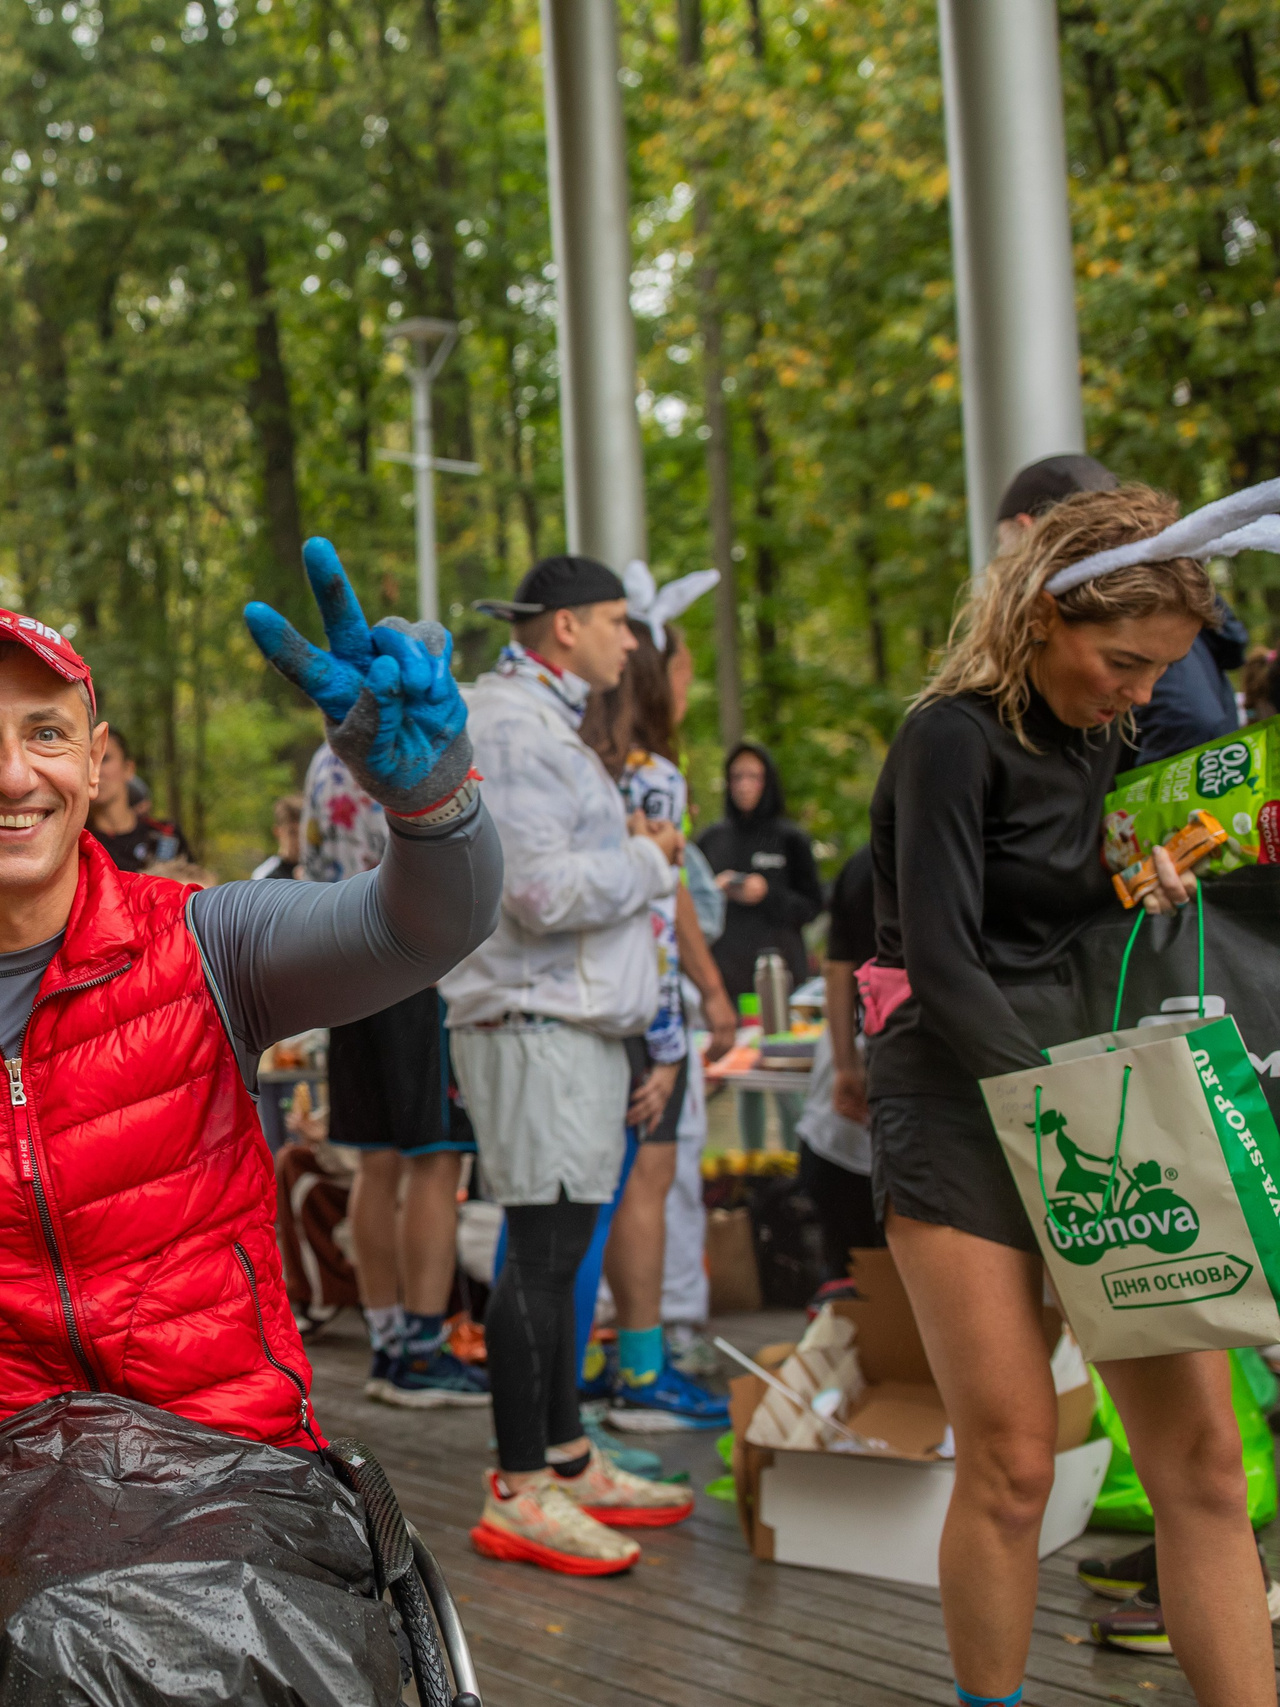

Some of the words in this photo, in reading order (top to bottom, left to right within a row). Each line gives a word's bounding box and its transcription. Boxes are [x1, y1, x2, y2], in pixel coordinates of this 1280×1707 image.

[18, 617, 61, 645] SIA
[1046, 1206, 1199, 1250] bionova
[1112, 1276, 1151, 1299] ДНЯ
[1153, 1264, 1239, 1291] ОСНОВА
